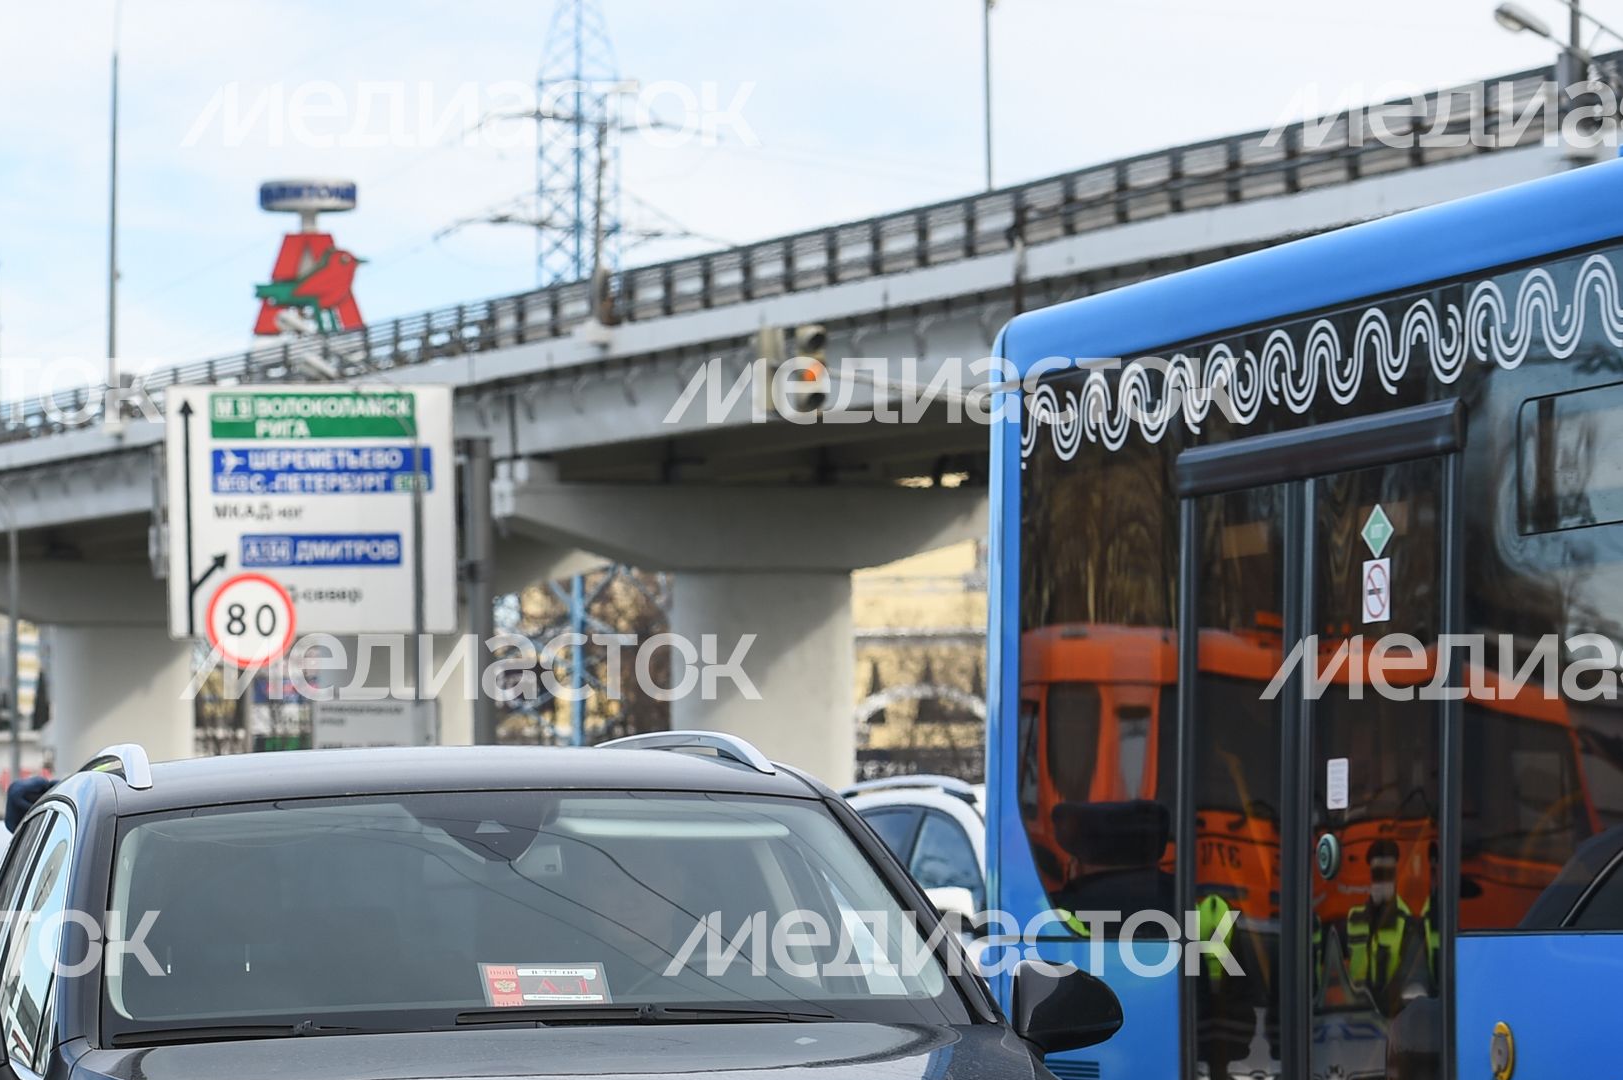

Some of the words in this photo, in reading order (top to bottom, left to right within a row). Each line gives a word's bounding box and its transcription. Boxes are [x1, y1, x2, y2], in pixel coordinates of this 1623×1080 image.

[256, 419, 311, 437] РИГА
[248, 449, 403, 470] ШЕРЕМЕТЬЕВО
[295, 539, 399, 563] ДМИТРОВ
[226, 604, 276, 636] 80
